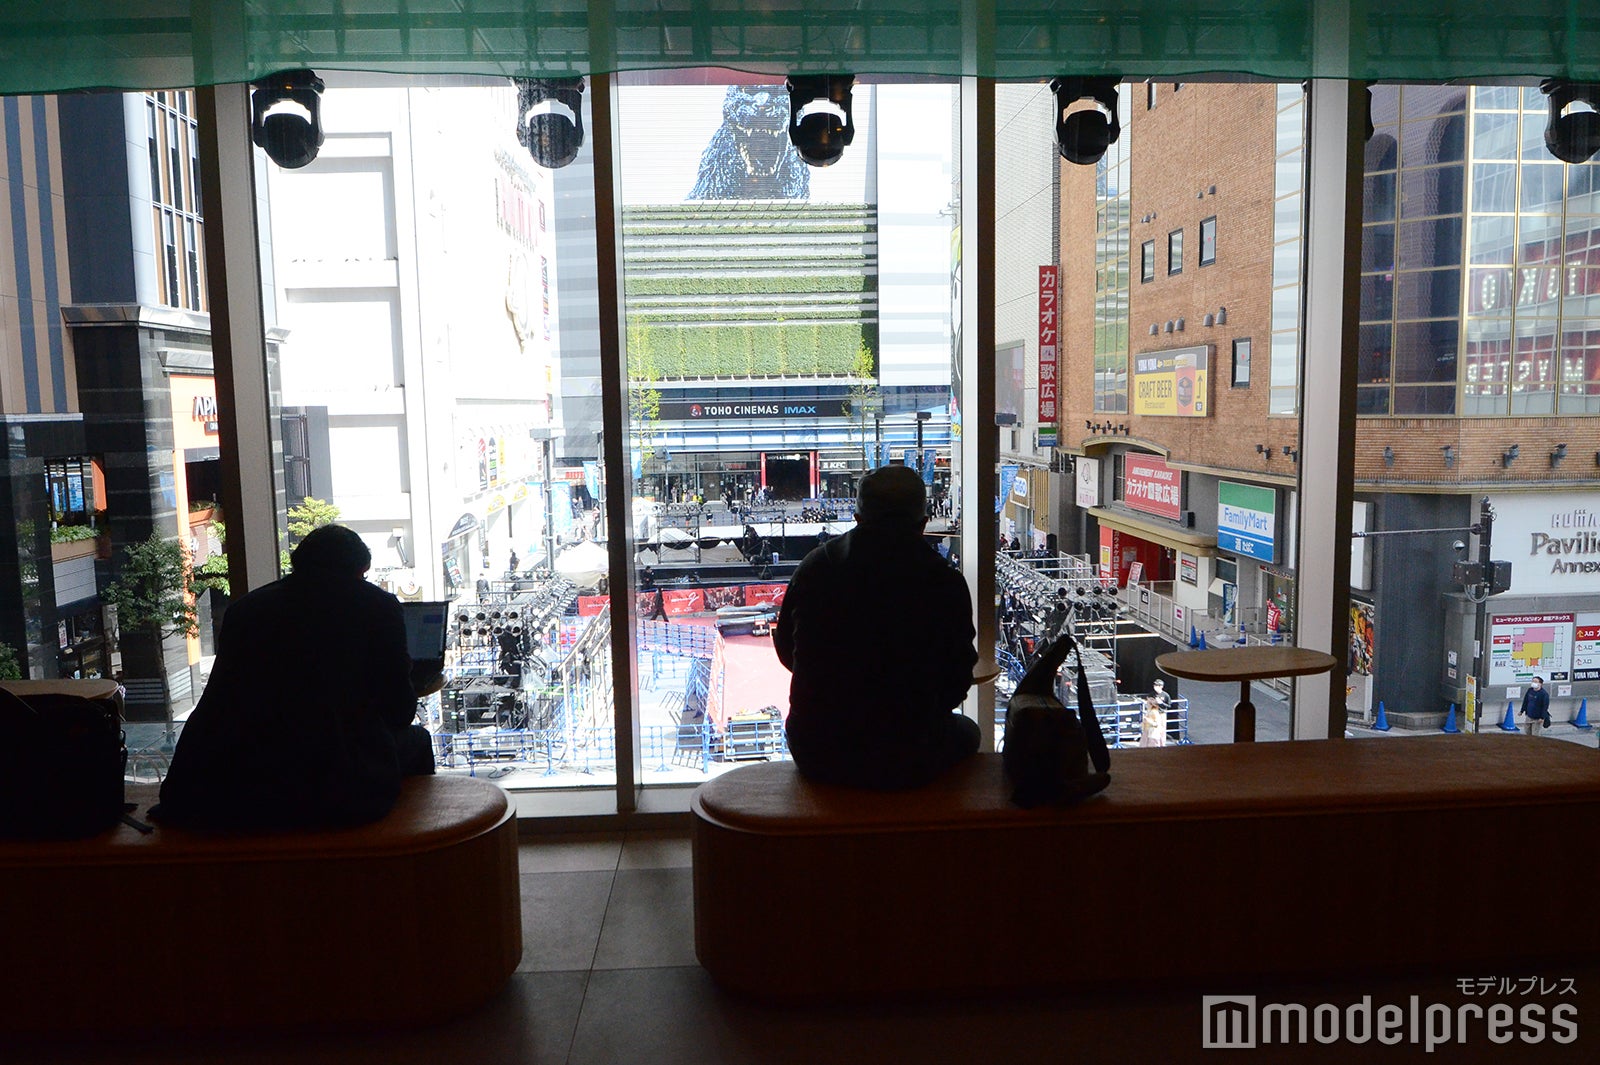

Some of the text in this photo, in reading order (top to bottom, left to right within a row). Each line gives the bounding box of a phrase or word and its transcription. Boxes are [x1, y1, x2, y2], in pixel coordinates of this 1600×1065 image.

[1139, 380, 1173, 398] CRAFT BEER
[704, 405, 816, 415] TOHO CINEMAS IMAX
[829, 461, 846, 469] KFC
[1224, 507, 1268, 531] FamilyMart
[1530, 531, 1600, 556] Pavili
